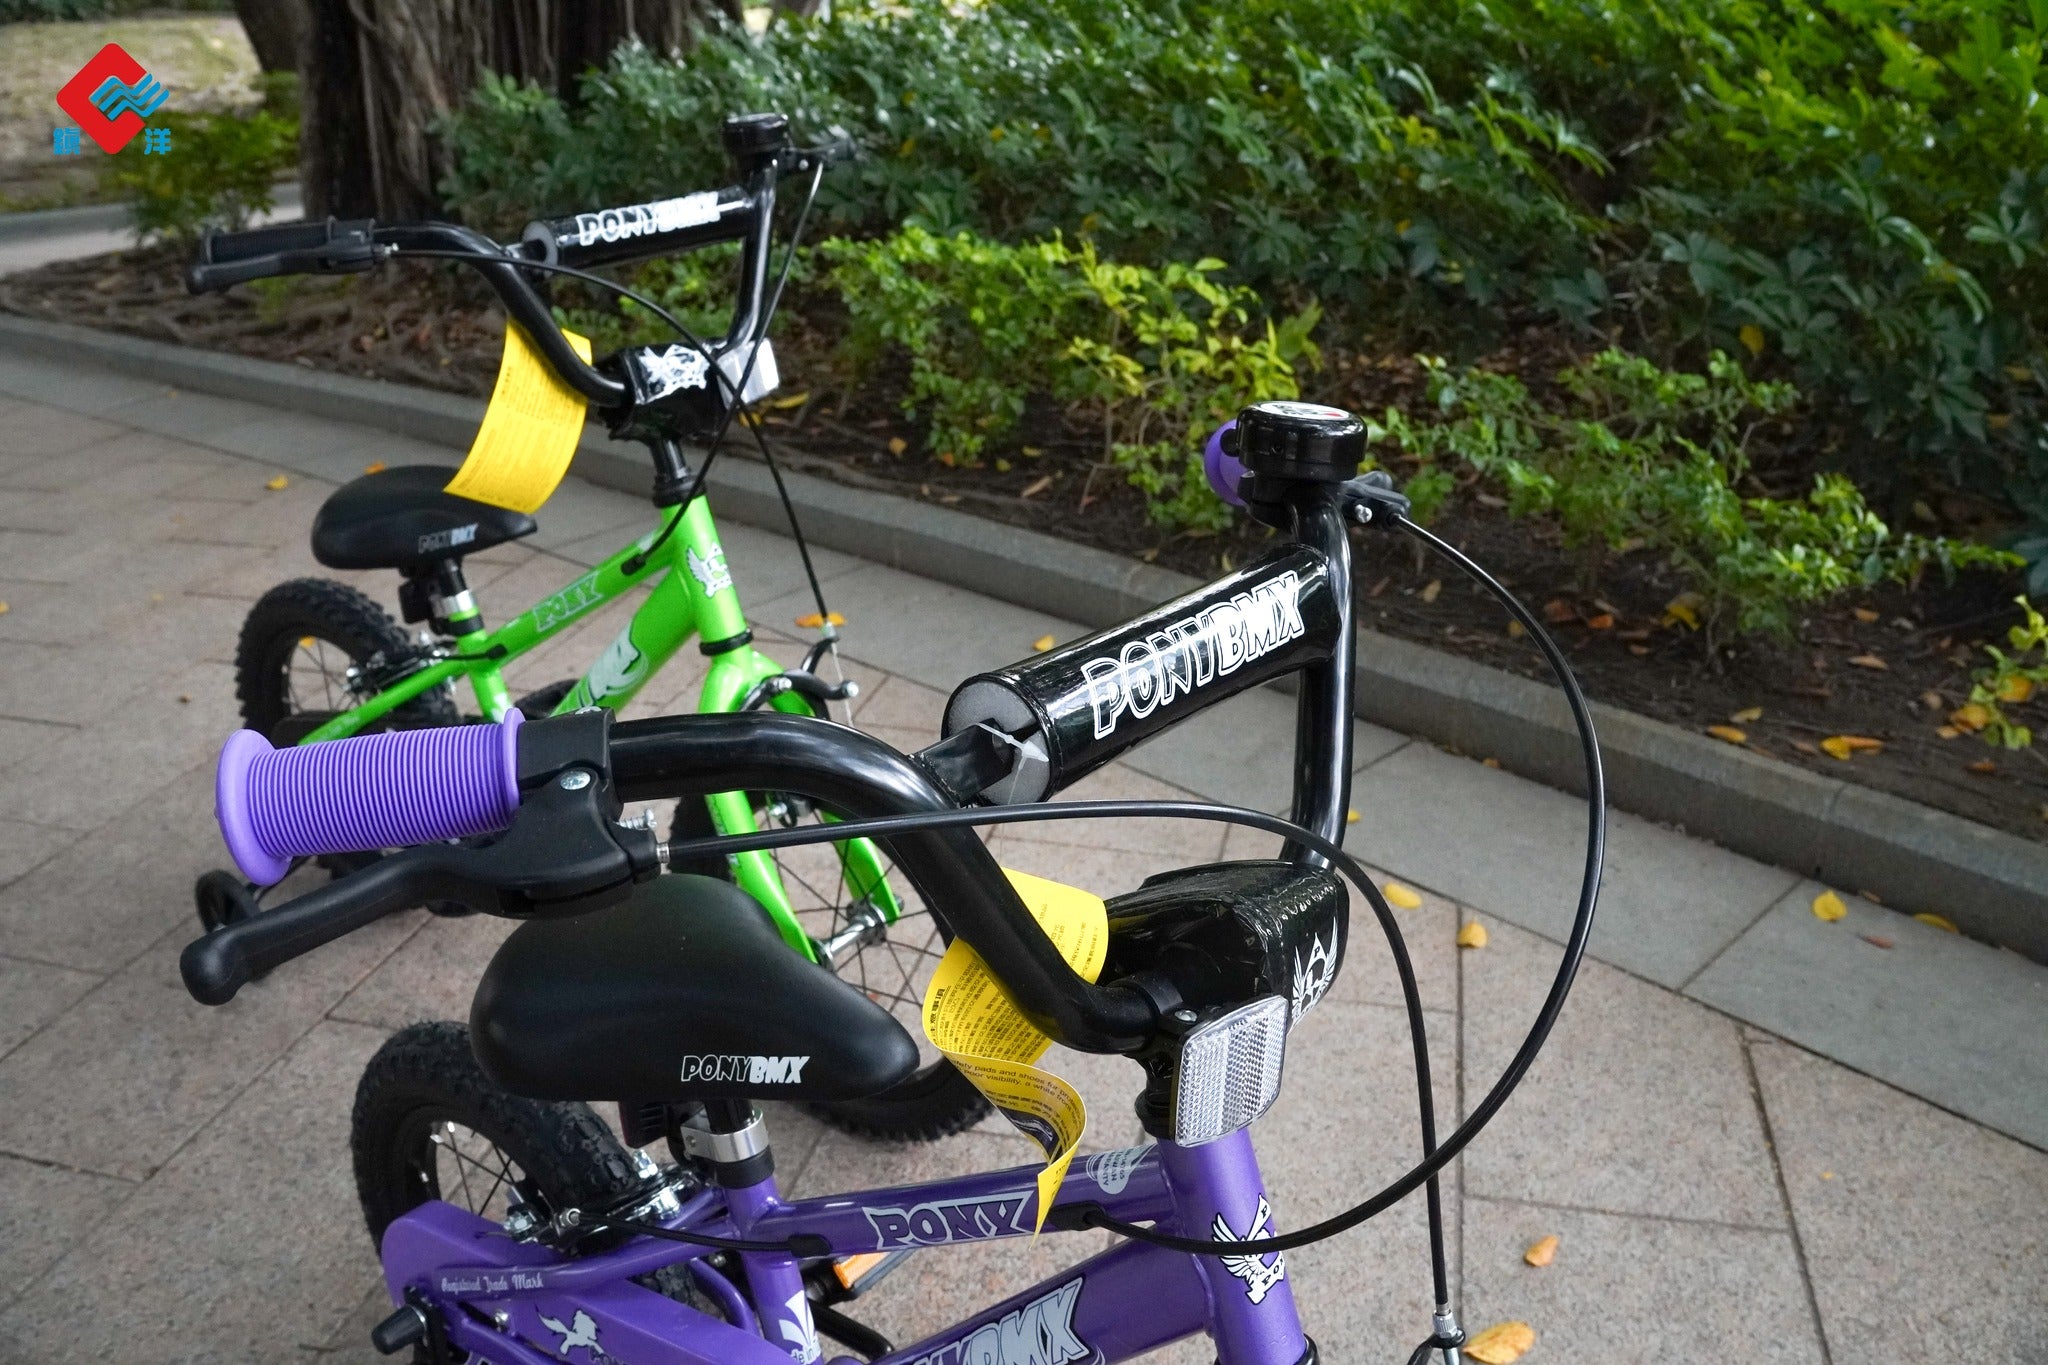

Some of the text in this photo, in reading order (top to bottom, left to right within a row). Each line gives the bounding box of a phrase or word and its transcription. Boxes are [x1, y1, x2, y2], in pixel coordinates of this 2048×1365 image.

[1081, 570, 1304, 740] PONYBMX
[680, 1054, 811, 1084] PONYBMX
[974, 1066, 997, 1074] pads
[999, 1069, 1017, 1078] and
[868, 1194, 1030, 1248] PONY
[511, 1271, 544, 1290] Mark
